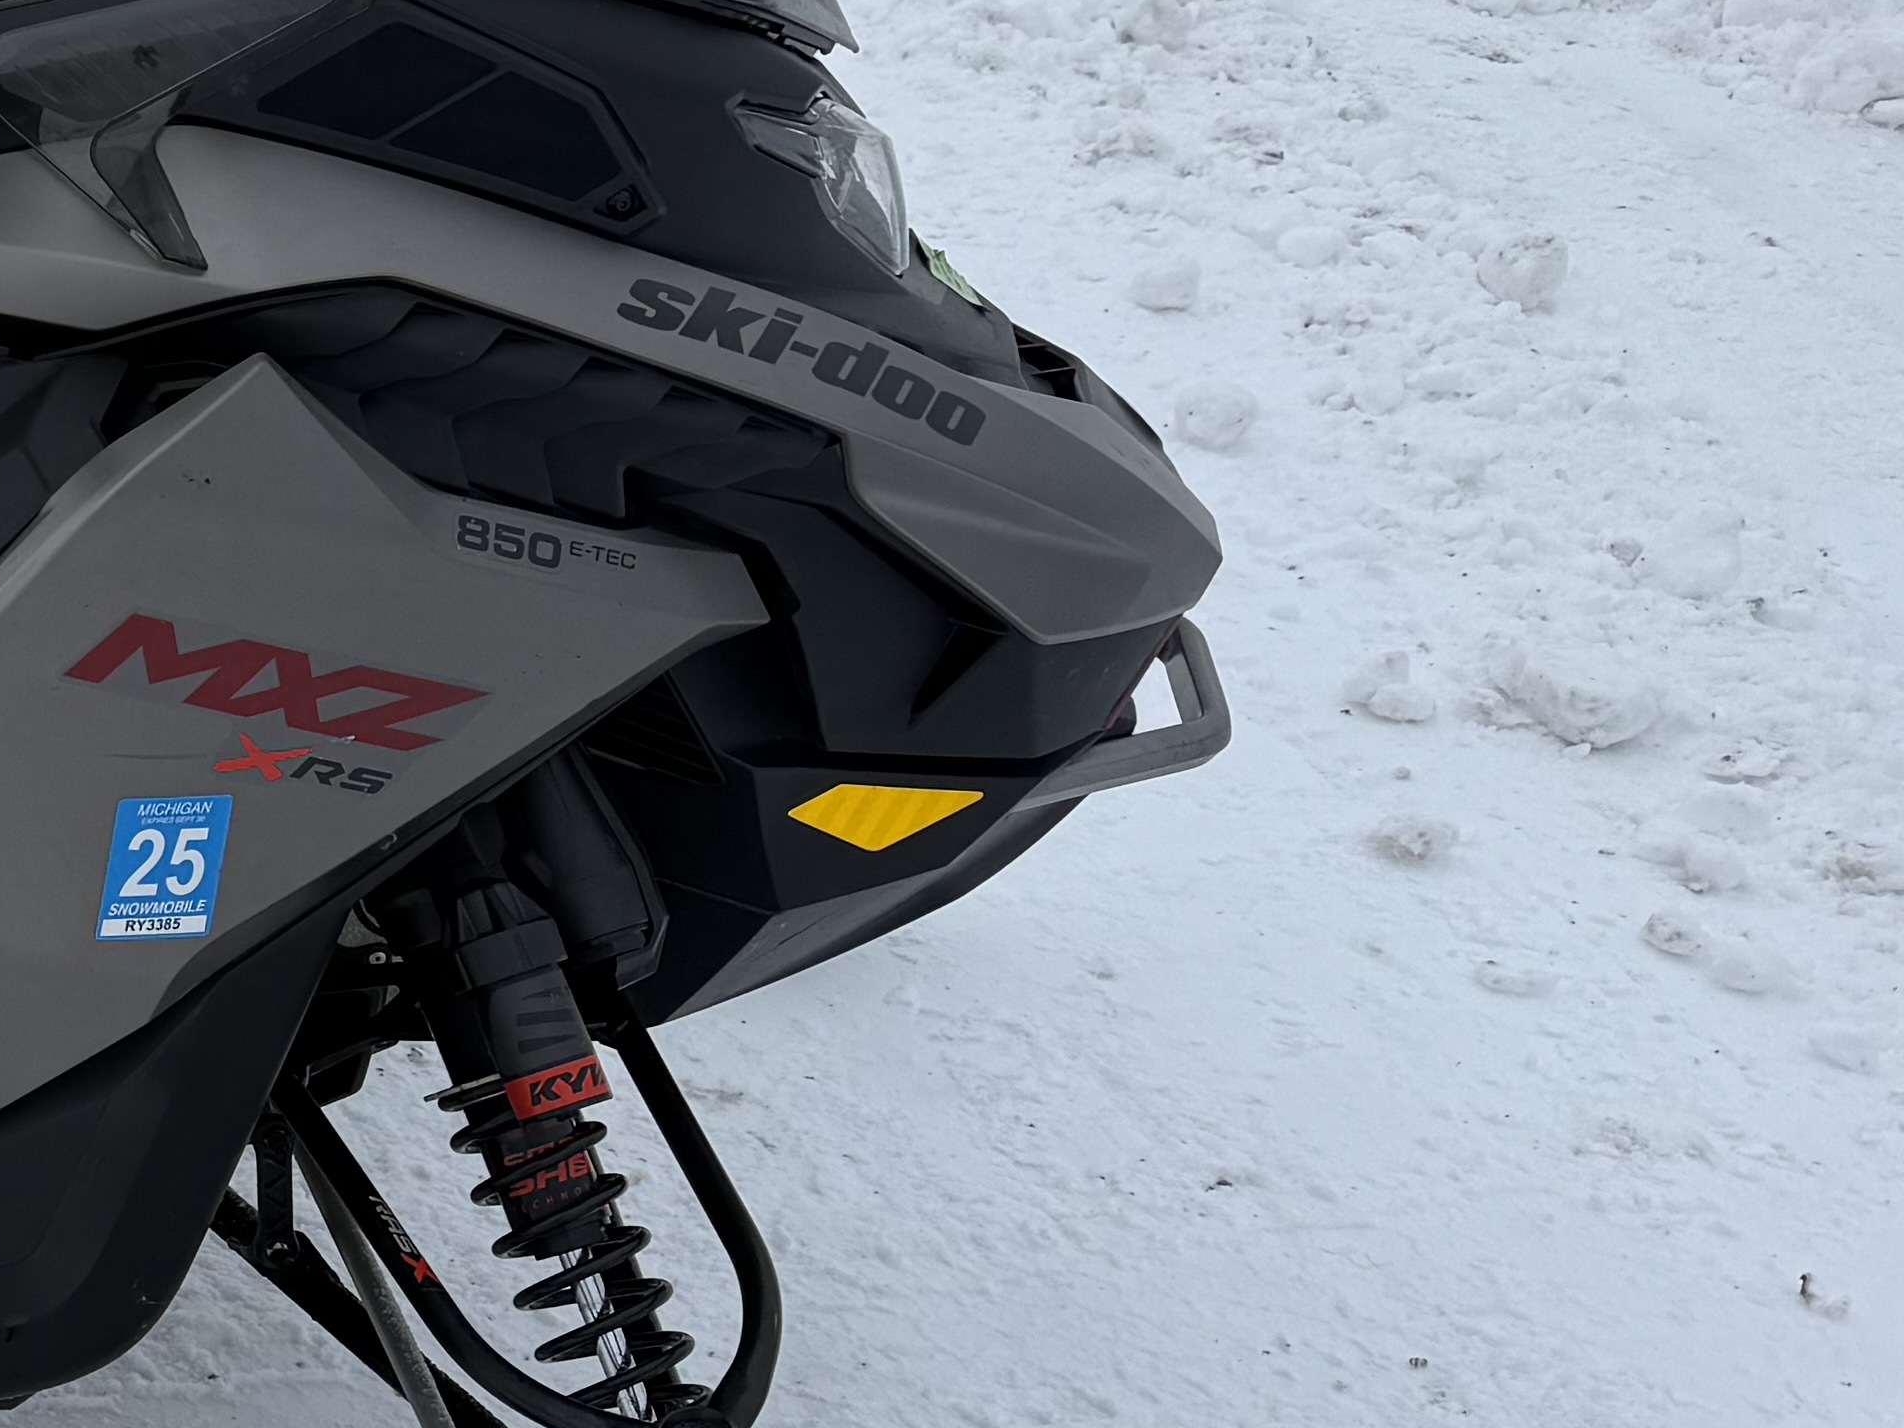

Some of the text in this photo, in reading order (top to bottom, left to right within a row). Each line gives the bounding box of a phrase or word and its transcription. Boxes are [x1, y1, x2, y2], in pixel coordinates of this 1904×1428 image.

[457, 515, 637, 570] 850 E-TEC
[64, 613, 492, 751] MXZ
[137, 801, 213, 818] MICHIGAN
[118, 827, 210, 898] 25
[108, 899, 207, 916] SNOWMOBILE
[124, 917, 182, 932] RY3385
